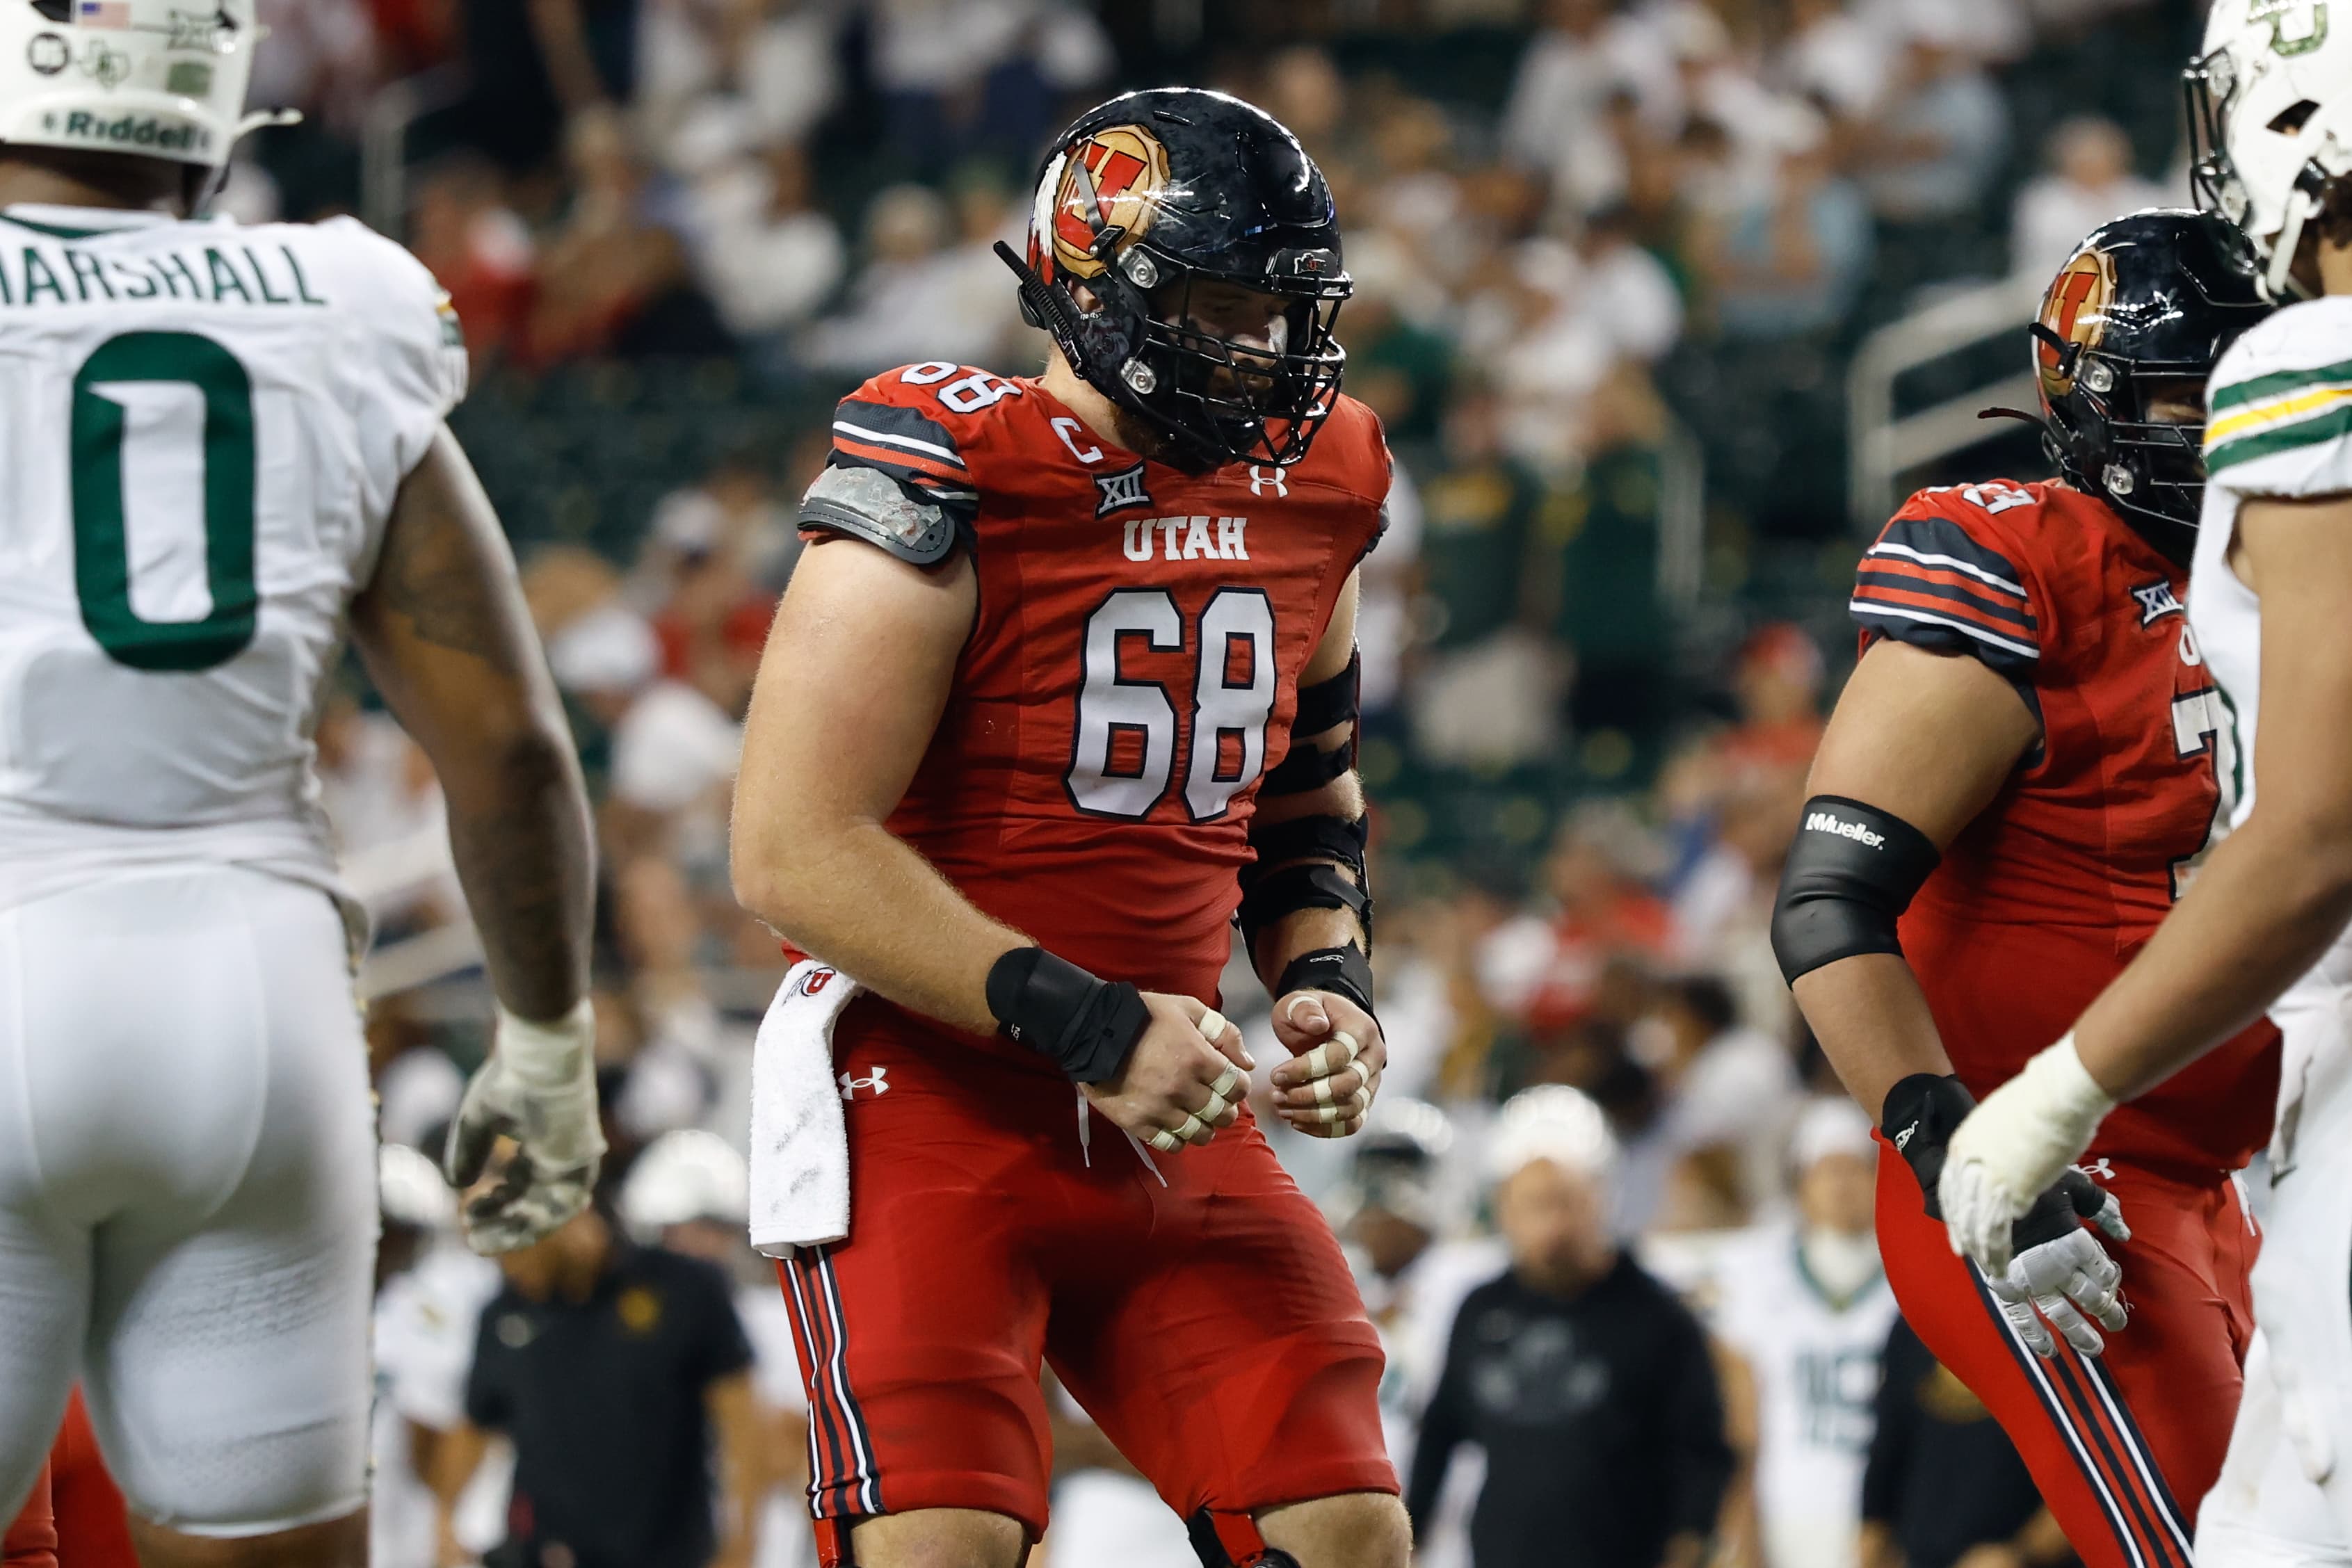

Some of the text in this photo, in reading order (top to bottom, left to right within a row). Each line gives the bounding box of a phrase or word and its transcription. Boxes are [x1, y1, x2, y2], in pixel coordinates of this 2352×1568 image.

[1050, 417, 1104, 464] C
[71, 330, 257, 673] 0
[1095, 464, 1152, 517] XII
[1123, 516, 1250, 562] UTAH
[1063, 585, 1278, 822] 68
[1806, 812, 1885, 847] Mueller
